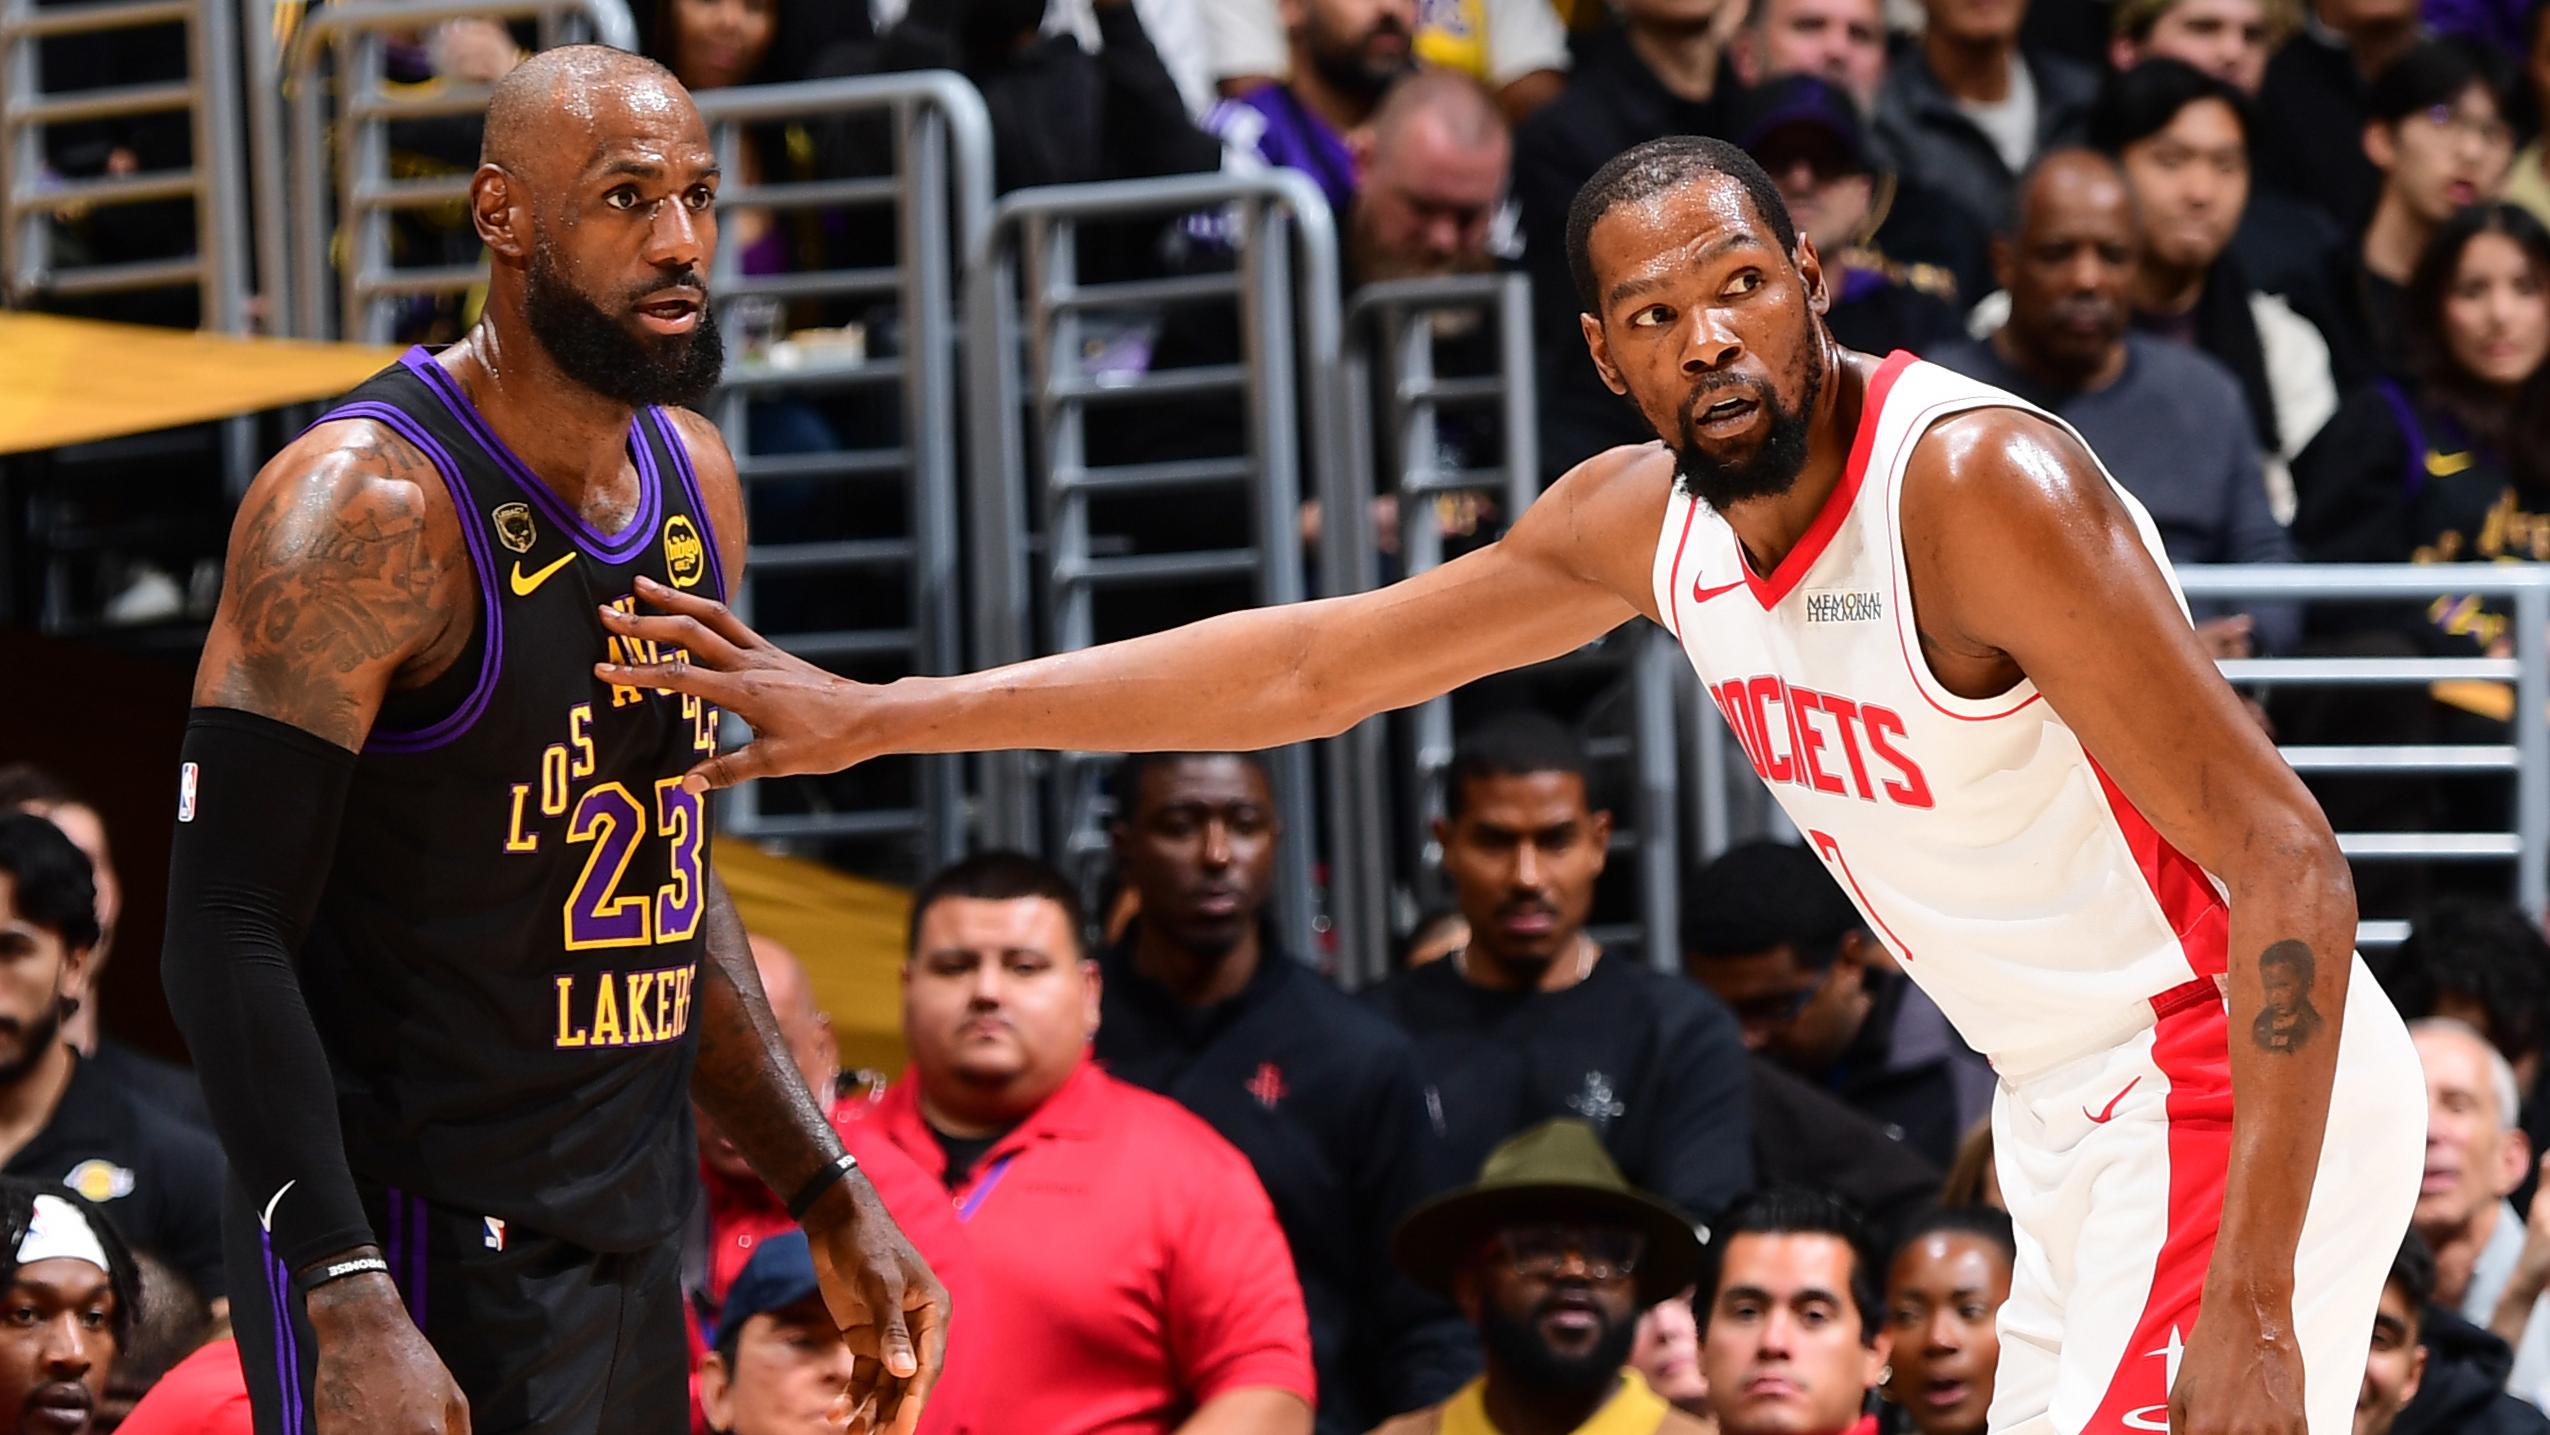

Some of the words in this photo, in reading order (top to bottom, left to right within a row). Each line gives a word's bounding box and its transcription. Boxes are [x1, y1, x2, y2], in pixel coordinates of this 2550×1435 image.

[1807, 592, 1881, 609] MEMORIAL
[1807, 606, 1881, 622] HERMANN
[504, 703, 595, 852] LOS
[1710, 675, 1936, 810] OCETS
[564, 775, 704, 950] 23
[1807, 828, 1914, 962] 7
